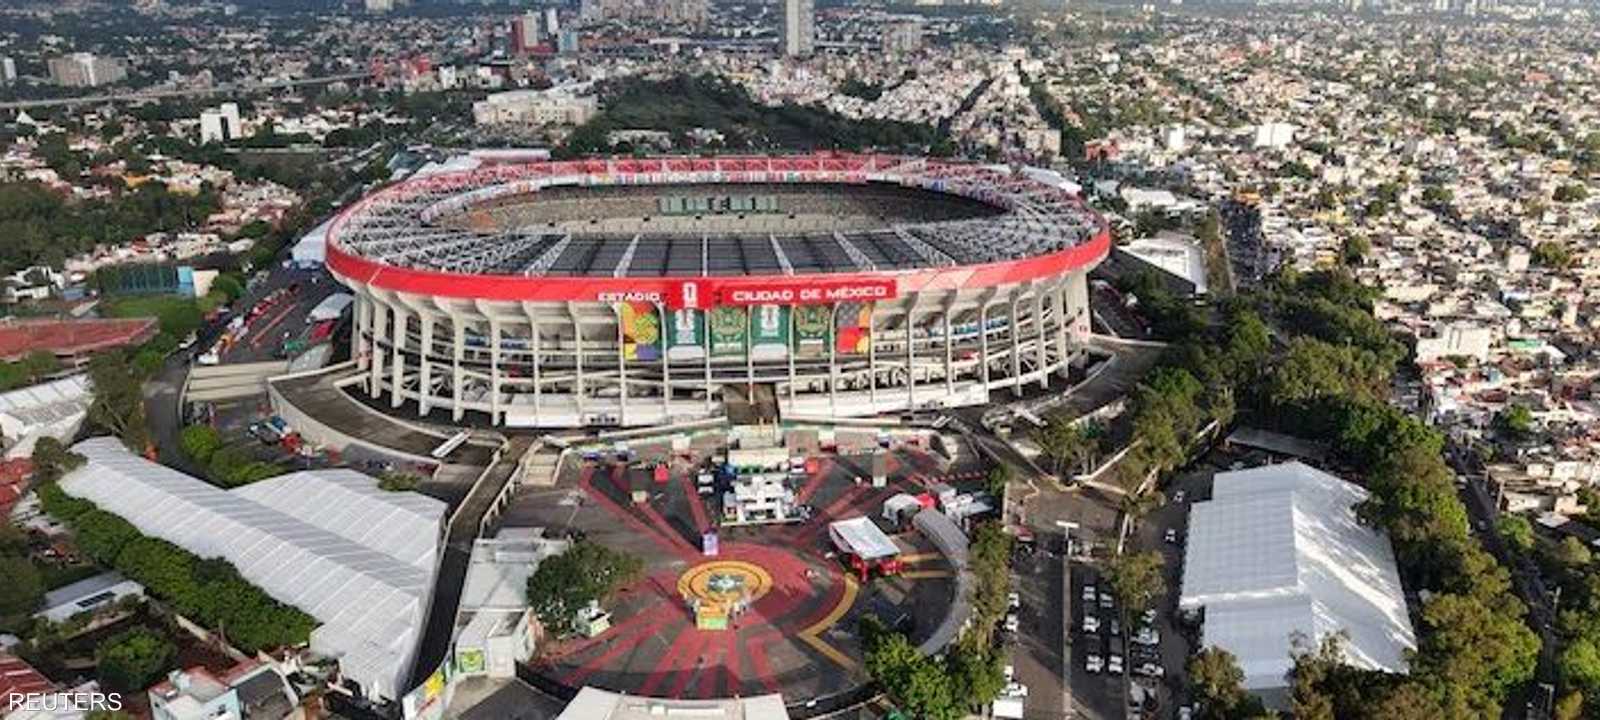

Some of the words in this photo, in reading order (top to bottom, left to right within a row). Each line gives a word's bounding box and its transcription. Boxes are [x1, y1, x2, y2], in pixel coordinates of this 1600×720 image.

[598, 292, 660, 302] ESTADIO
[732, 289, 793, 302] CIUDAD
[799, 288, 821, 300] DE
[826, 286, 888, 299] MÉXICO
